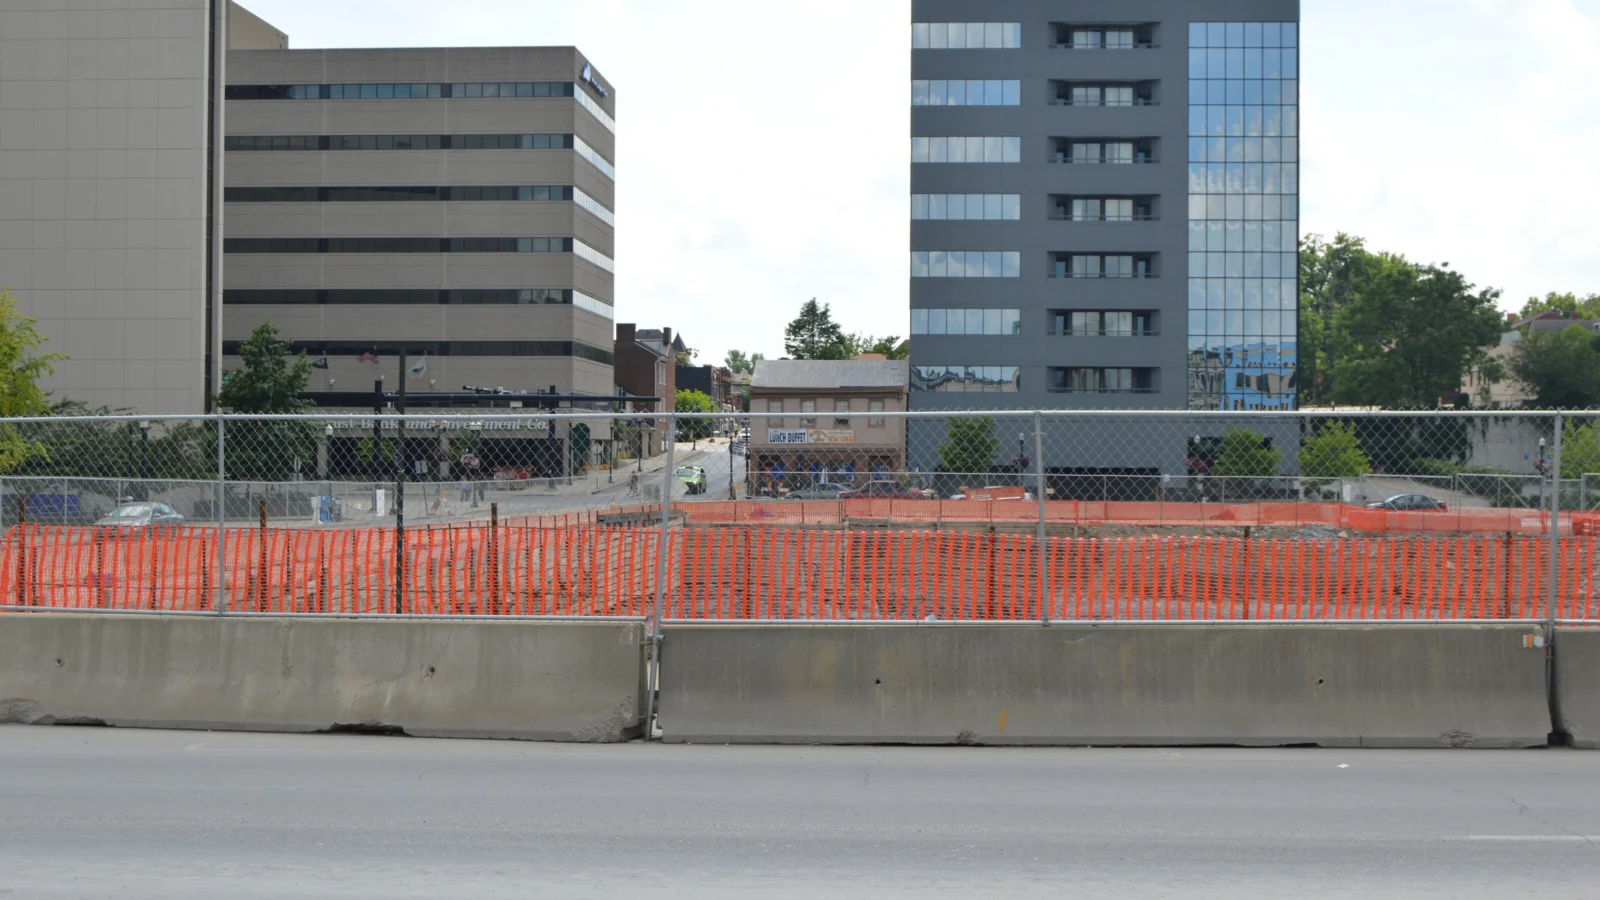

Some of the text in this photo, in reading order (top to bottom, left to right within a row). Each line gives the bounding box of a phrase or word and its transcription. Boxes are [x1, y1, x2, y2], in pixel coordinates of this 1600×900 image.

[405, 419, 432, 429] and
[439, 418, 521, 430] Invement
[527, 418, 550, 430] Co.
[769, 432, 786, 442] LUNCH
[787, 432, 806, 442] BUFFET
